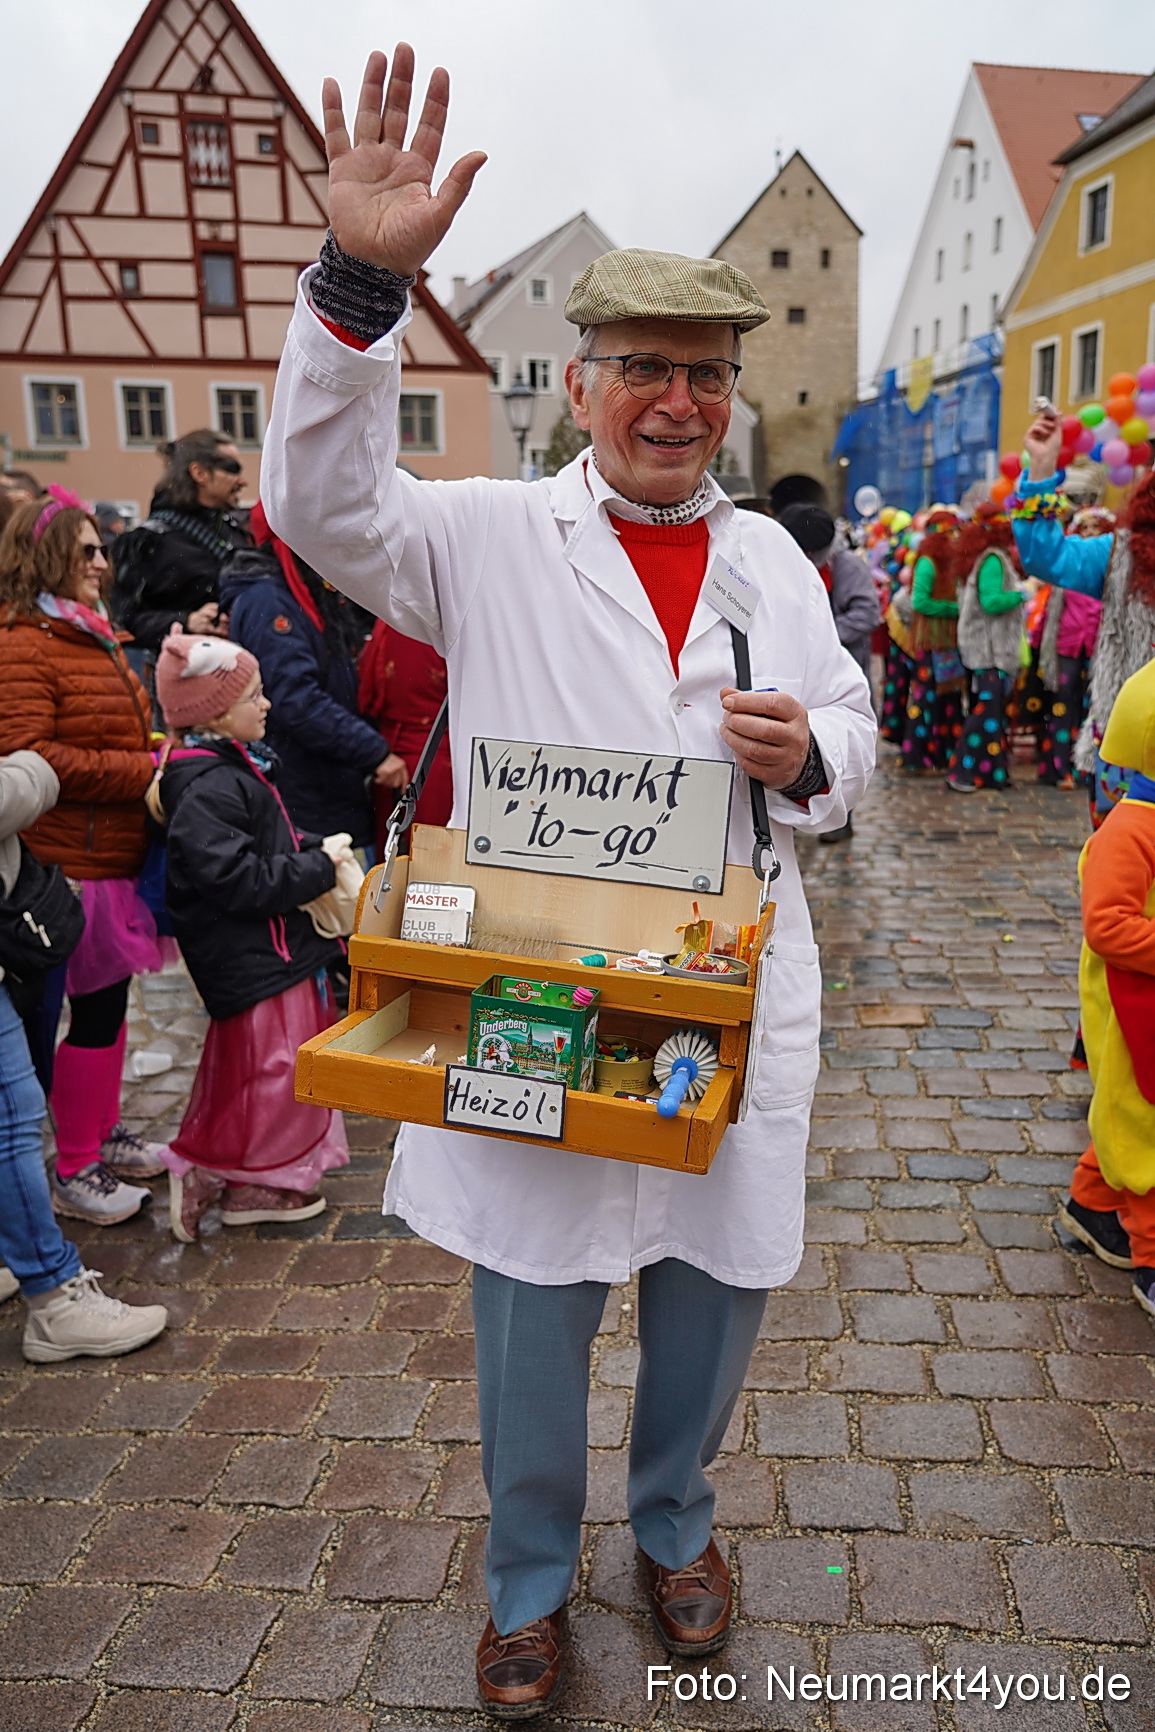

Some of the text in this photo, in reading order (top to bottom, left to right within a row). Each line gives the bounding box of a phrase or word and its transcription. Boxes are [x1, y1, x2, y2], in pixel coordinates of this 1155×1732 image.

[711, 578, 727, 596] Hans
[479, 741, 691, 810] Viehmarkt
[407, 883, 441, 895] CLUB
[405, 893, 459, 908] MASTER
[402, 919, 436, 932] CLUB
[479, 1018, 528, 1036] Underberg
[449, 1077, 547, 1125] Heizöl
